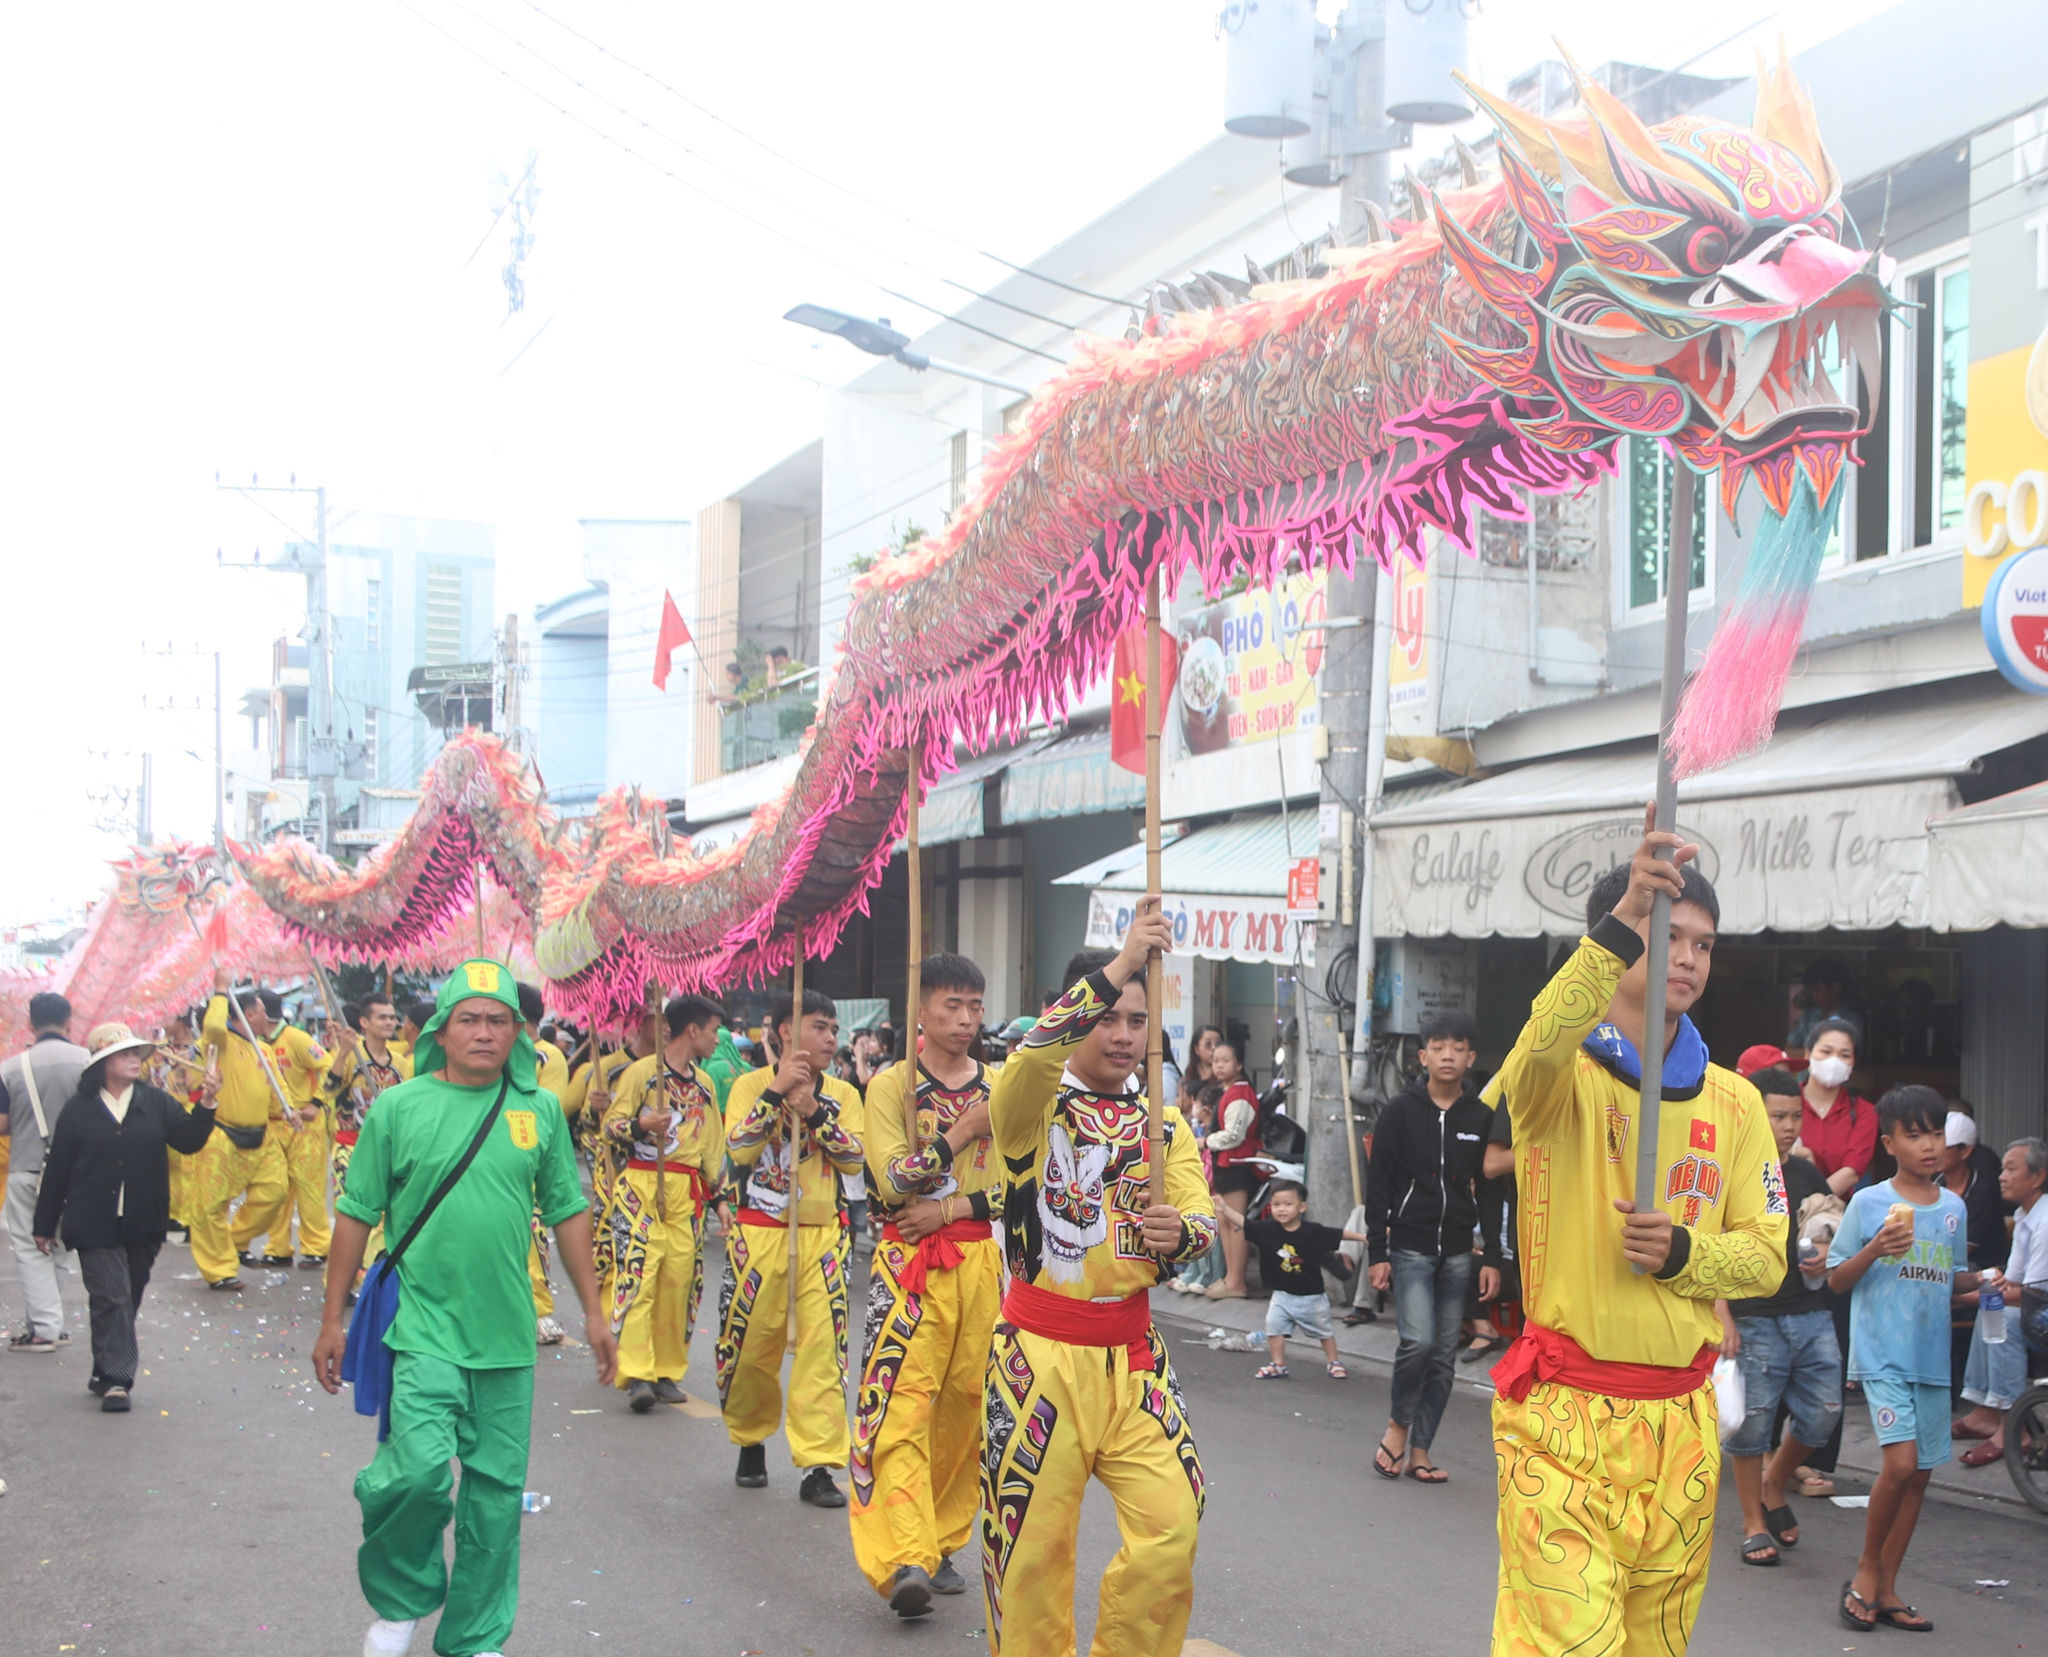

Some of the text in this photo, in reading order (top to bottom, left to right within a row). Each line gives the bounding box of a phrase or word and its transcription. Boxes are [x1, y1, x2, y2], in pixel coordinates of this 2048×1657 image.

[1735, 818, 1815, 877] Milk
[1827, 811, 1884, 871] Tea
[1193, 910, 1238, 949] MY
[1244, 913, 1288, 953] MY
